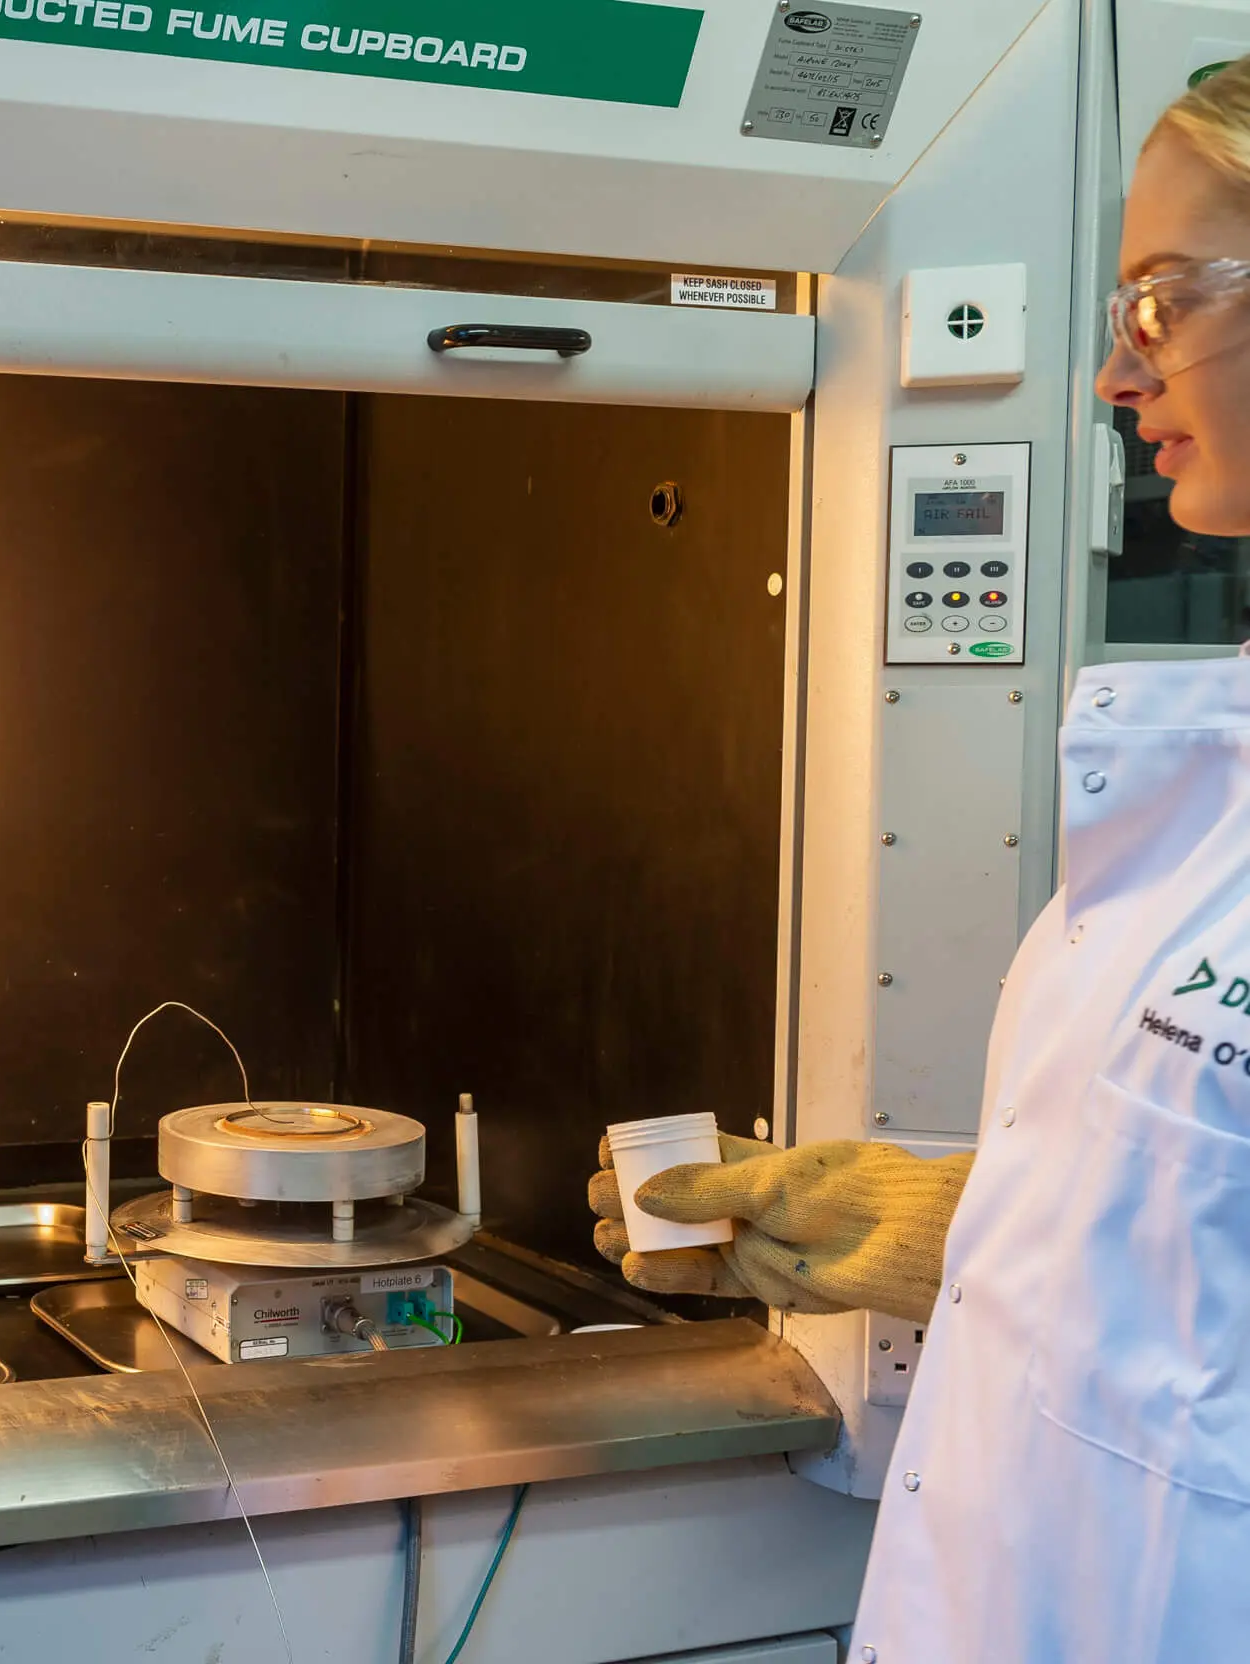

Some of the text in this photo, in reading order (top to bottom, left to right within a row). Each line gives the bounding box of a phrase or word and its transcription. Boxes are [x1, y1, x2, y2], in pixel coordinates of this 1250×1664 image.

[789, 16, 826, 28] SAFELAB
[167, 8, 288, 47] FUME
[301, 24, 527, 72] CUPBOARD
[683, 277, 762, 291] KEEP SASH CLOSED
[679, 290, 766, 305] WHENEVER POSSIBLE
[924, 507, 991, 520] AIR FAIL
[1139, 1007, 1205, 1053] Helena
[372, 1276, 413, 1288] Hotplate
[414, 1274, 422, 1284] 6
[253, 1306, 300, 1320] Chilworth
